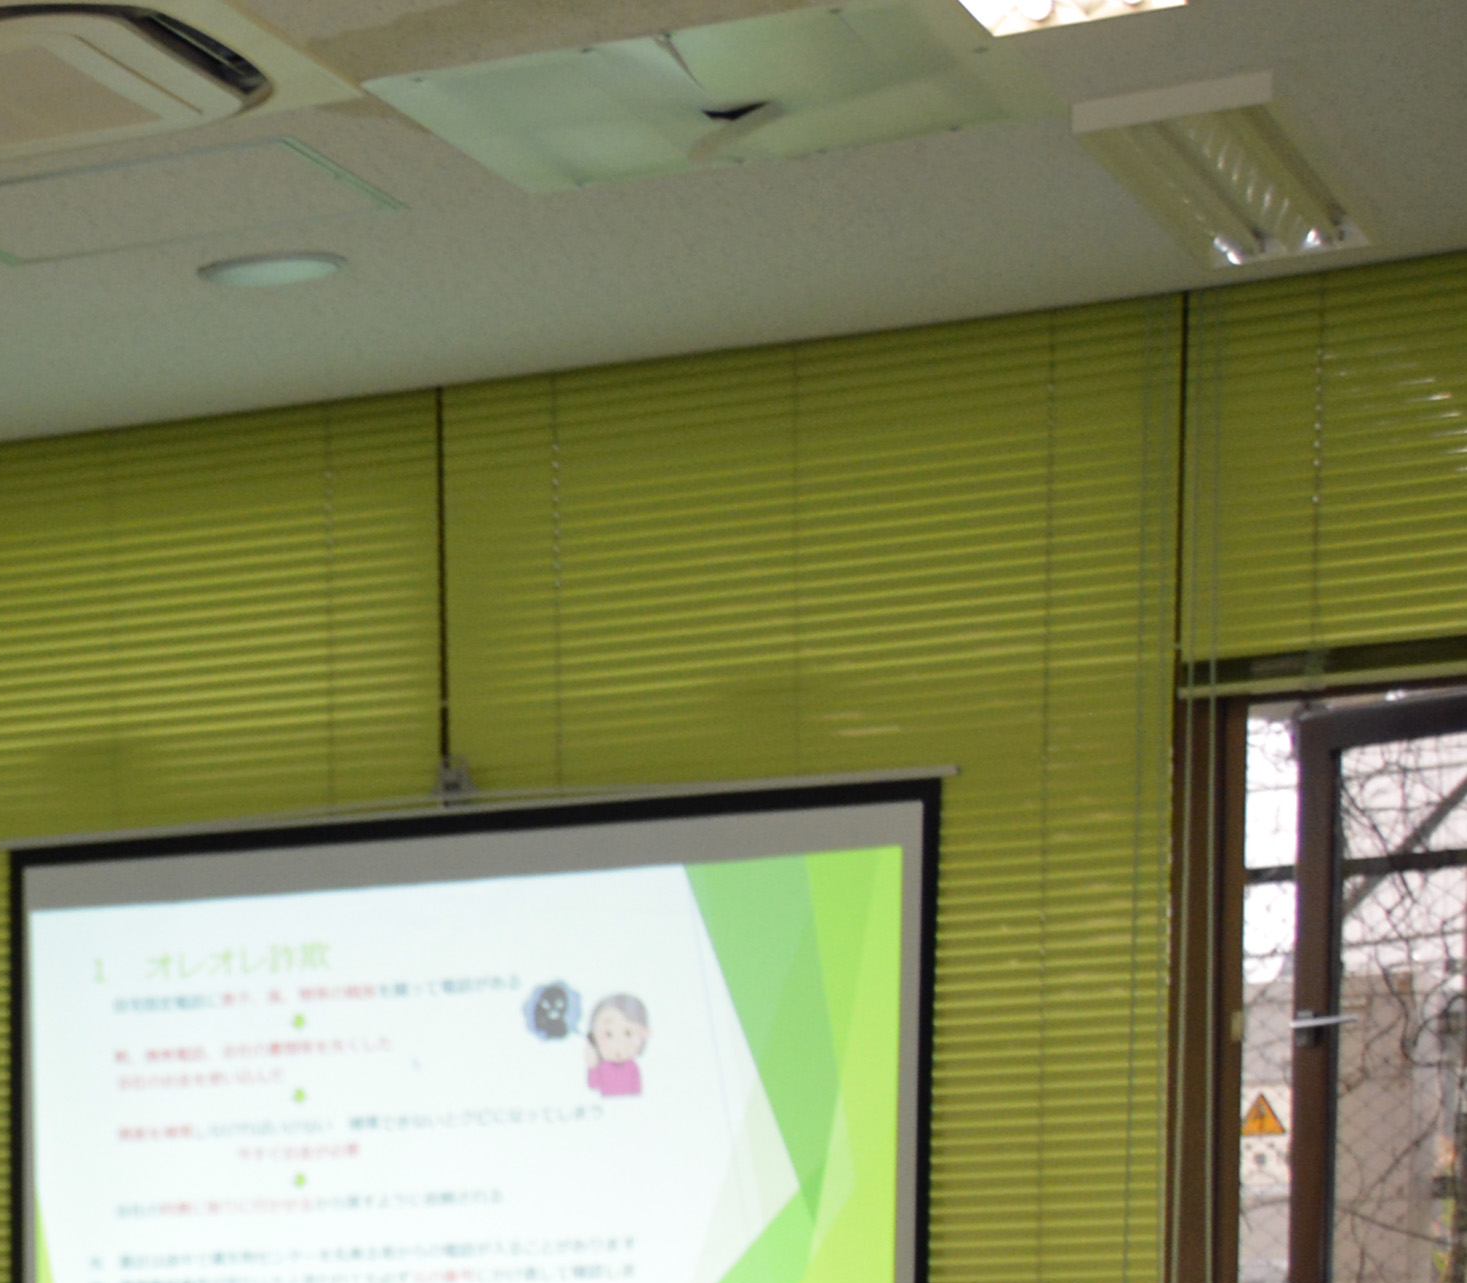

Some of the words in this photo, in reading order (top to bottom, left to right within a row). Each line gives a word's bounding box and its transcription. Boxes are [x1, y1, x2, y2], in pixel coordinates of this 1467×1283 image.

[145, 941, 332, 982] オレオレ詐欺
